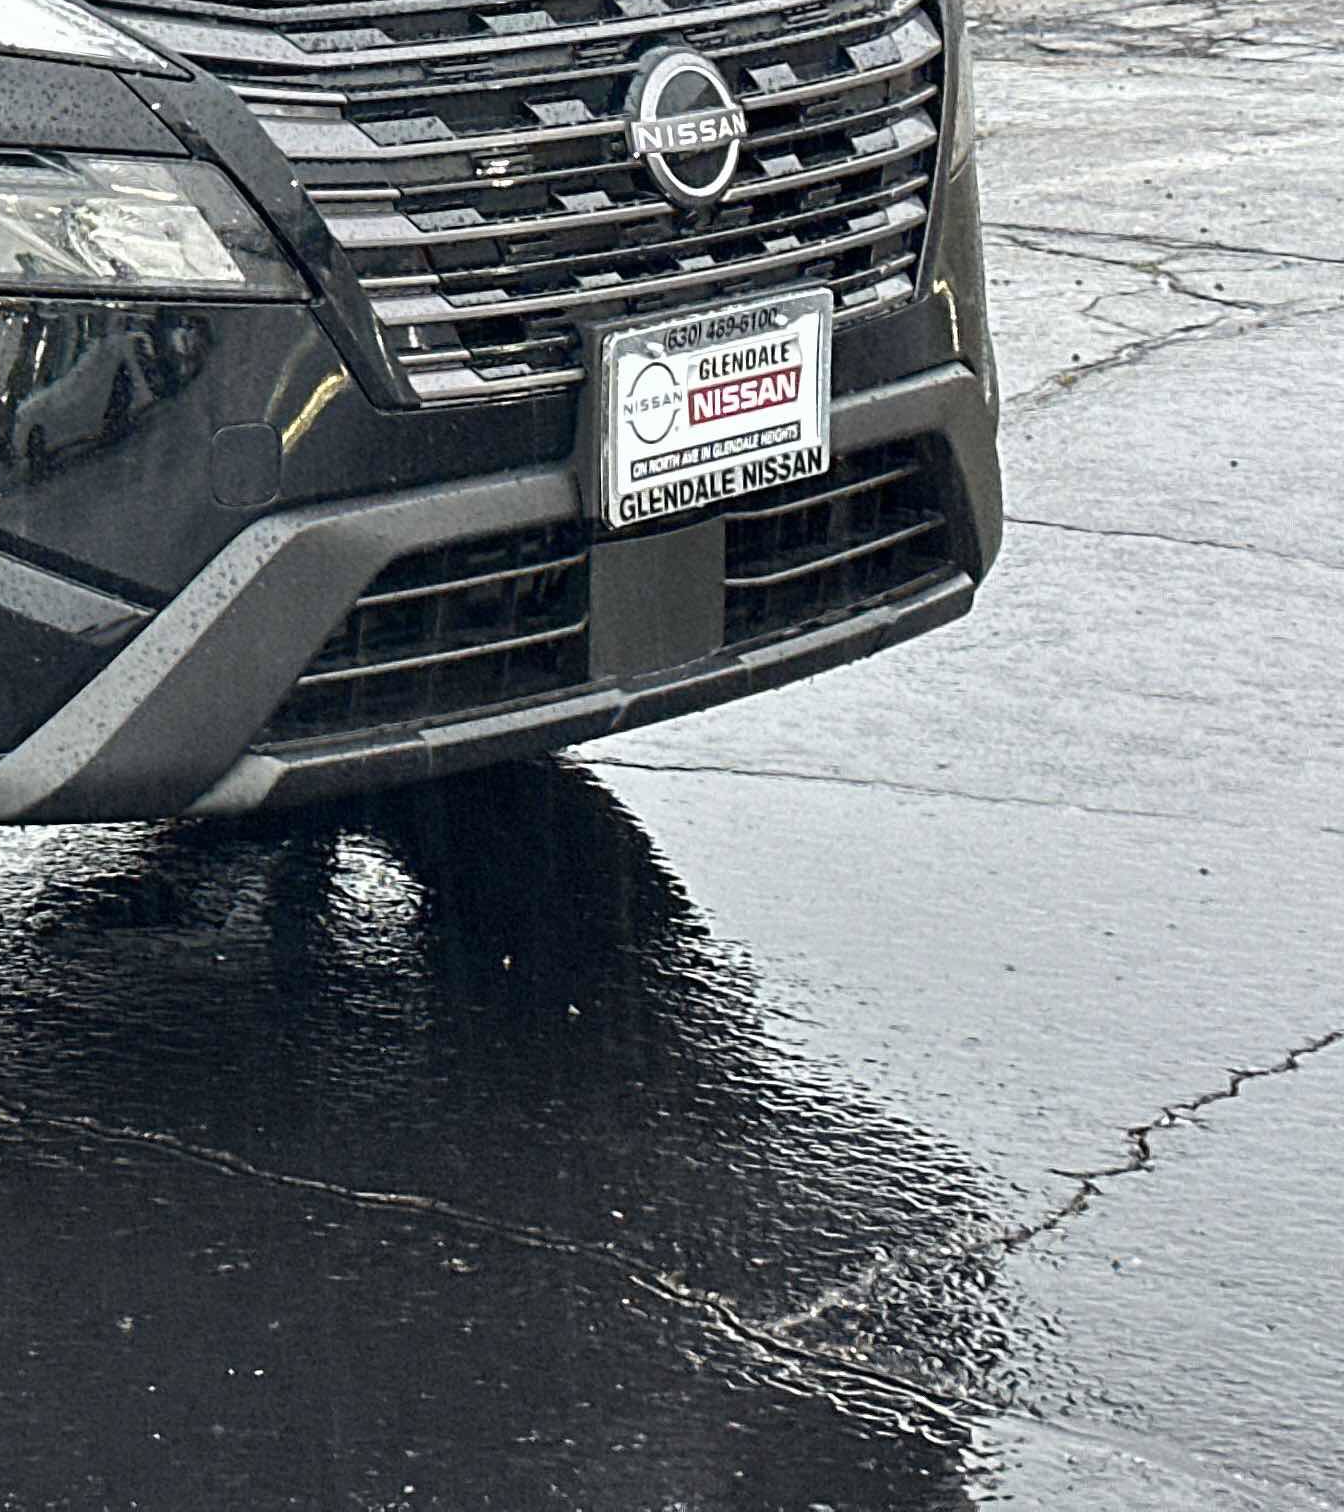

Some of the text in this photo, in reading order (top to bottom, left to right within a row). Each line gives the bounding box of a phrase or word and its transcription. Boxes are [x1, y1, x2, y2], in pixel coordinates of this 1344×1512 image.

[637, 110, 746, 151] NISSAN
[664, 321, 702, 352] (630)
[699, 340, 789, 380] GLENDALE
[623, 391, 683, 416] NISSAN
[693, 371, 796, 421] NISSAN
[633, 462, 647, 477] ON
[700, 444, 711, 462] IN
[713, 433, 759, 458] GLENDALE
[619, 445, 823, 522] GLENDALE NISSAN
